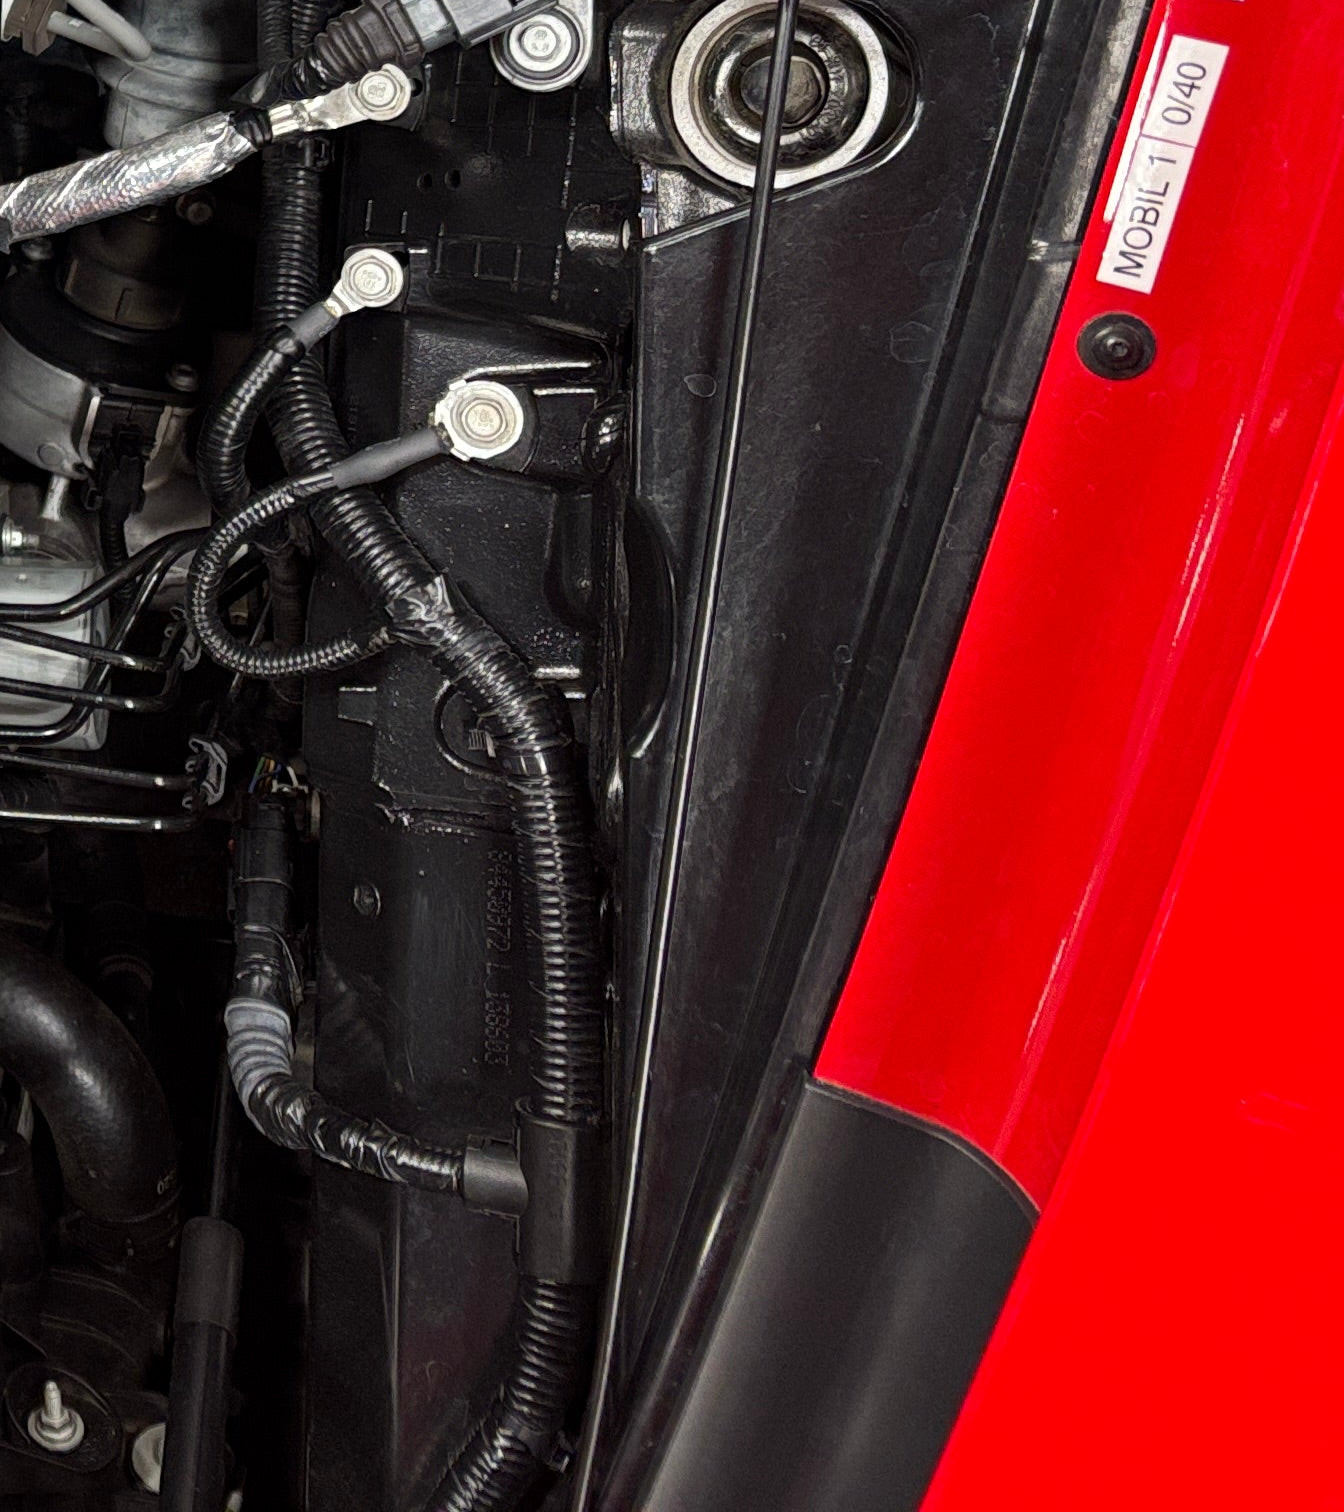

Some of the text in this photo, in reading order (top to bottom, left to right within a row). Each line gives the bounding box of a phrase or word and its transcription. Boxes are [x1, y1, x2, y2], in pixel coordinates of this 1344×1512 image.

[1112, 60, 1208, 279] MOBIL 1 0/40
